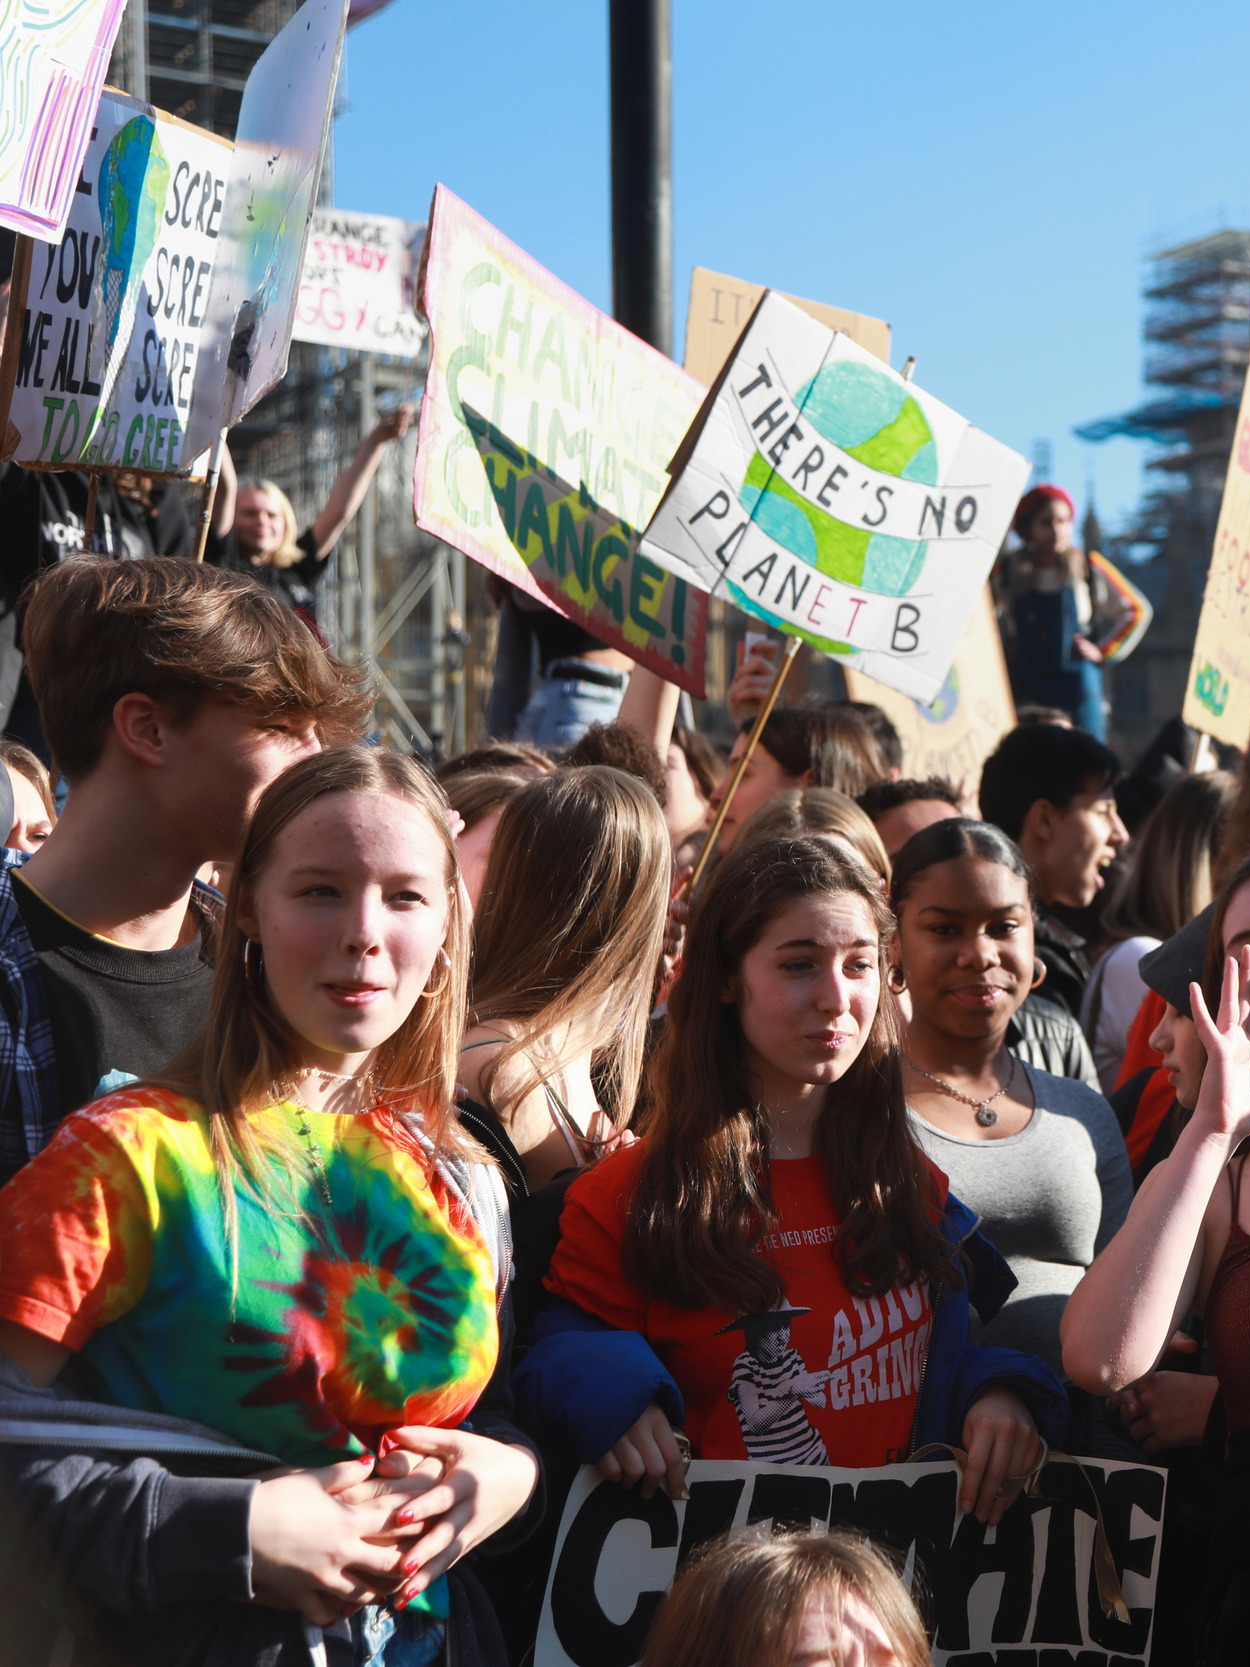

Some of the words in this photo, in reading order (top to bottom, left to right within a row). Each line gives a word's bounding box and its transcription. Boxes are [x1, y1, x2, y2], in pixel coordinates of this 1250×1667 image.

[15, 309, 53, 389] WE
[51, 317, 101, 397] ALL
[37, 396, 80, 464] TO
[738, 362, 894, 527] THERE'S
[918, 494, 979, 538] NO
[443, 427, 690, 668] CHANGE!
[688, 489, 870, 640] PLANET
[891, 602, 921, 652] B
